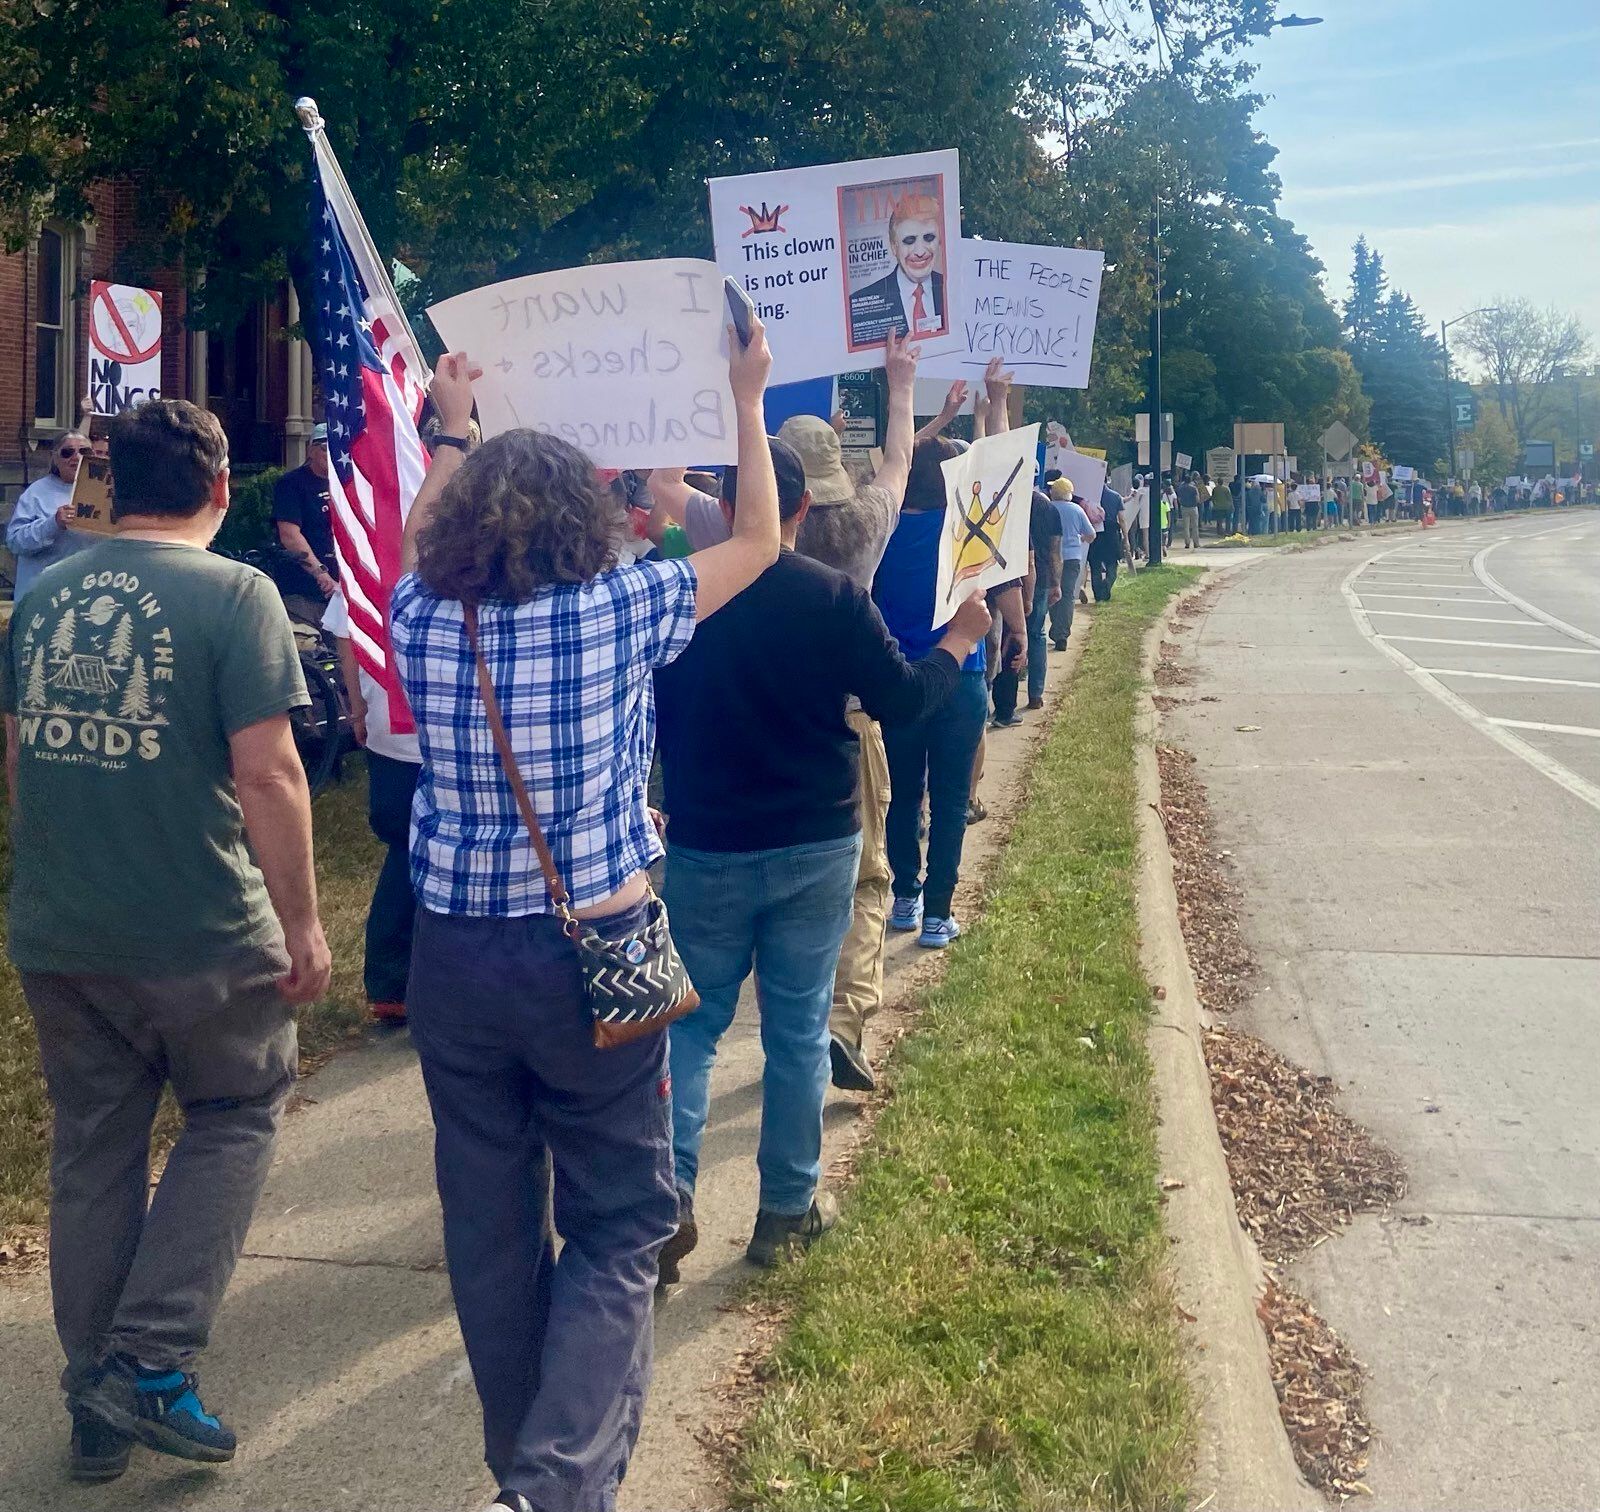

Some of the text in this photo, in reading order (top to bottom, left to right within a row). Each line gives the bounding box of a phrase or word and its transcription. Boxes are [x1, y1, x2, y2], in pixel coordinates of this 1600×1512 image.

[742, 237, 835, 262] This clown
[848, 240, 883, 254] CLOWN
[848, 249, 888, 264] IN CHIEF
[745, 267, 828, 291] is not our
[974, 258, 1093, 299] THE PEOPLE
[753, 302, 790, 320] ing.
[975, 296, 1044, 318] MEANS
[965, 314, 1081, 358] VERYONE!
[91, 358, 122, 386] NO
[1456, 404, 1472, 421] E
[51, 586, 71, 608] IS
[82, 571, 140, 593] GOOD
[137, 592, 161, 619] IN
[152, 627, 174, 682] THE
[18, 717, 161, 760] WOODS
